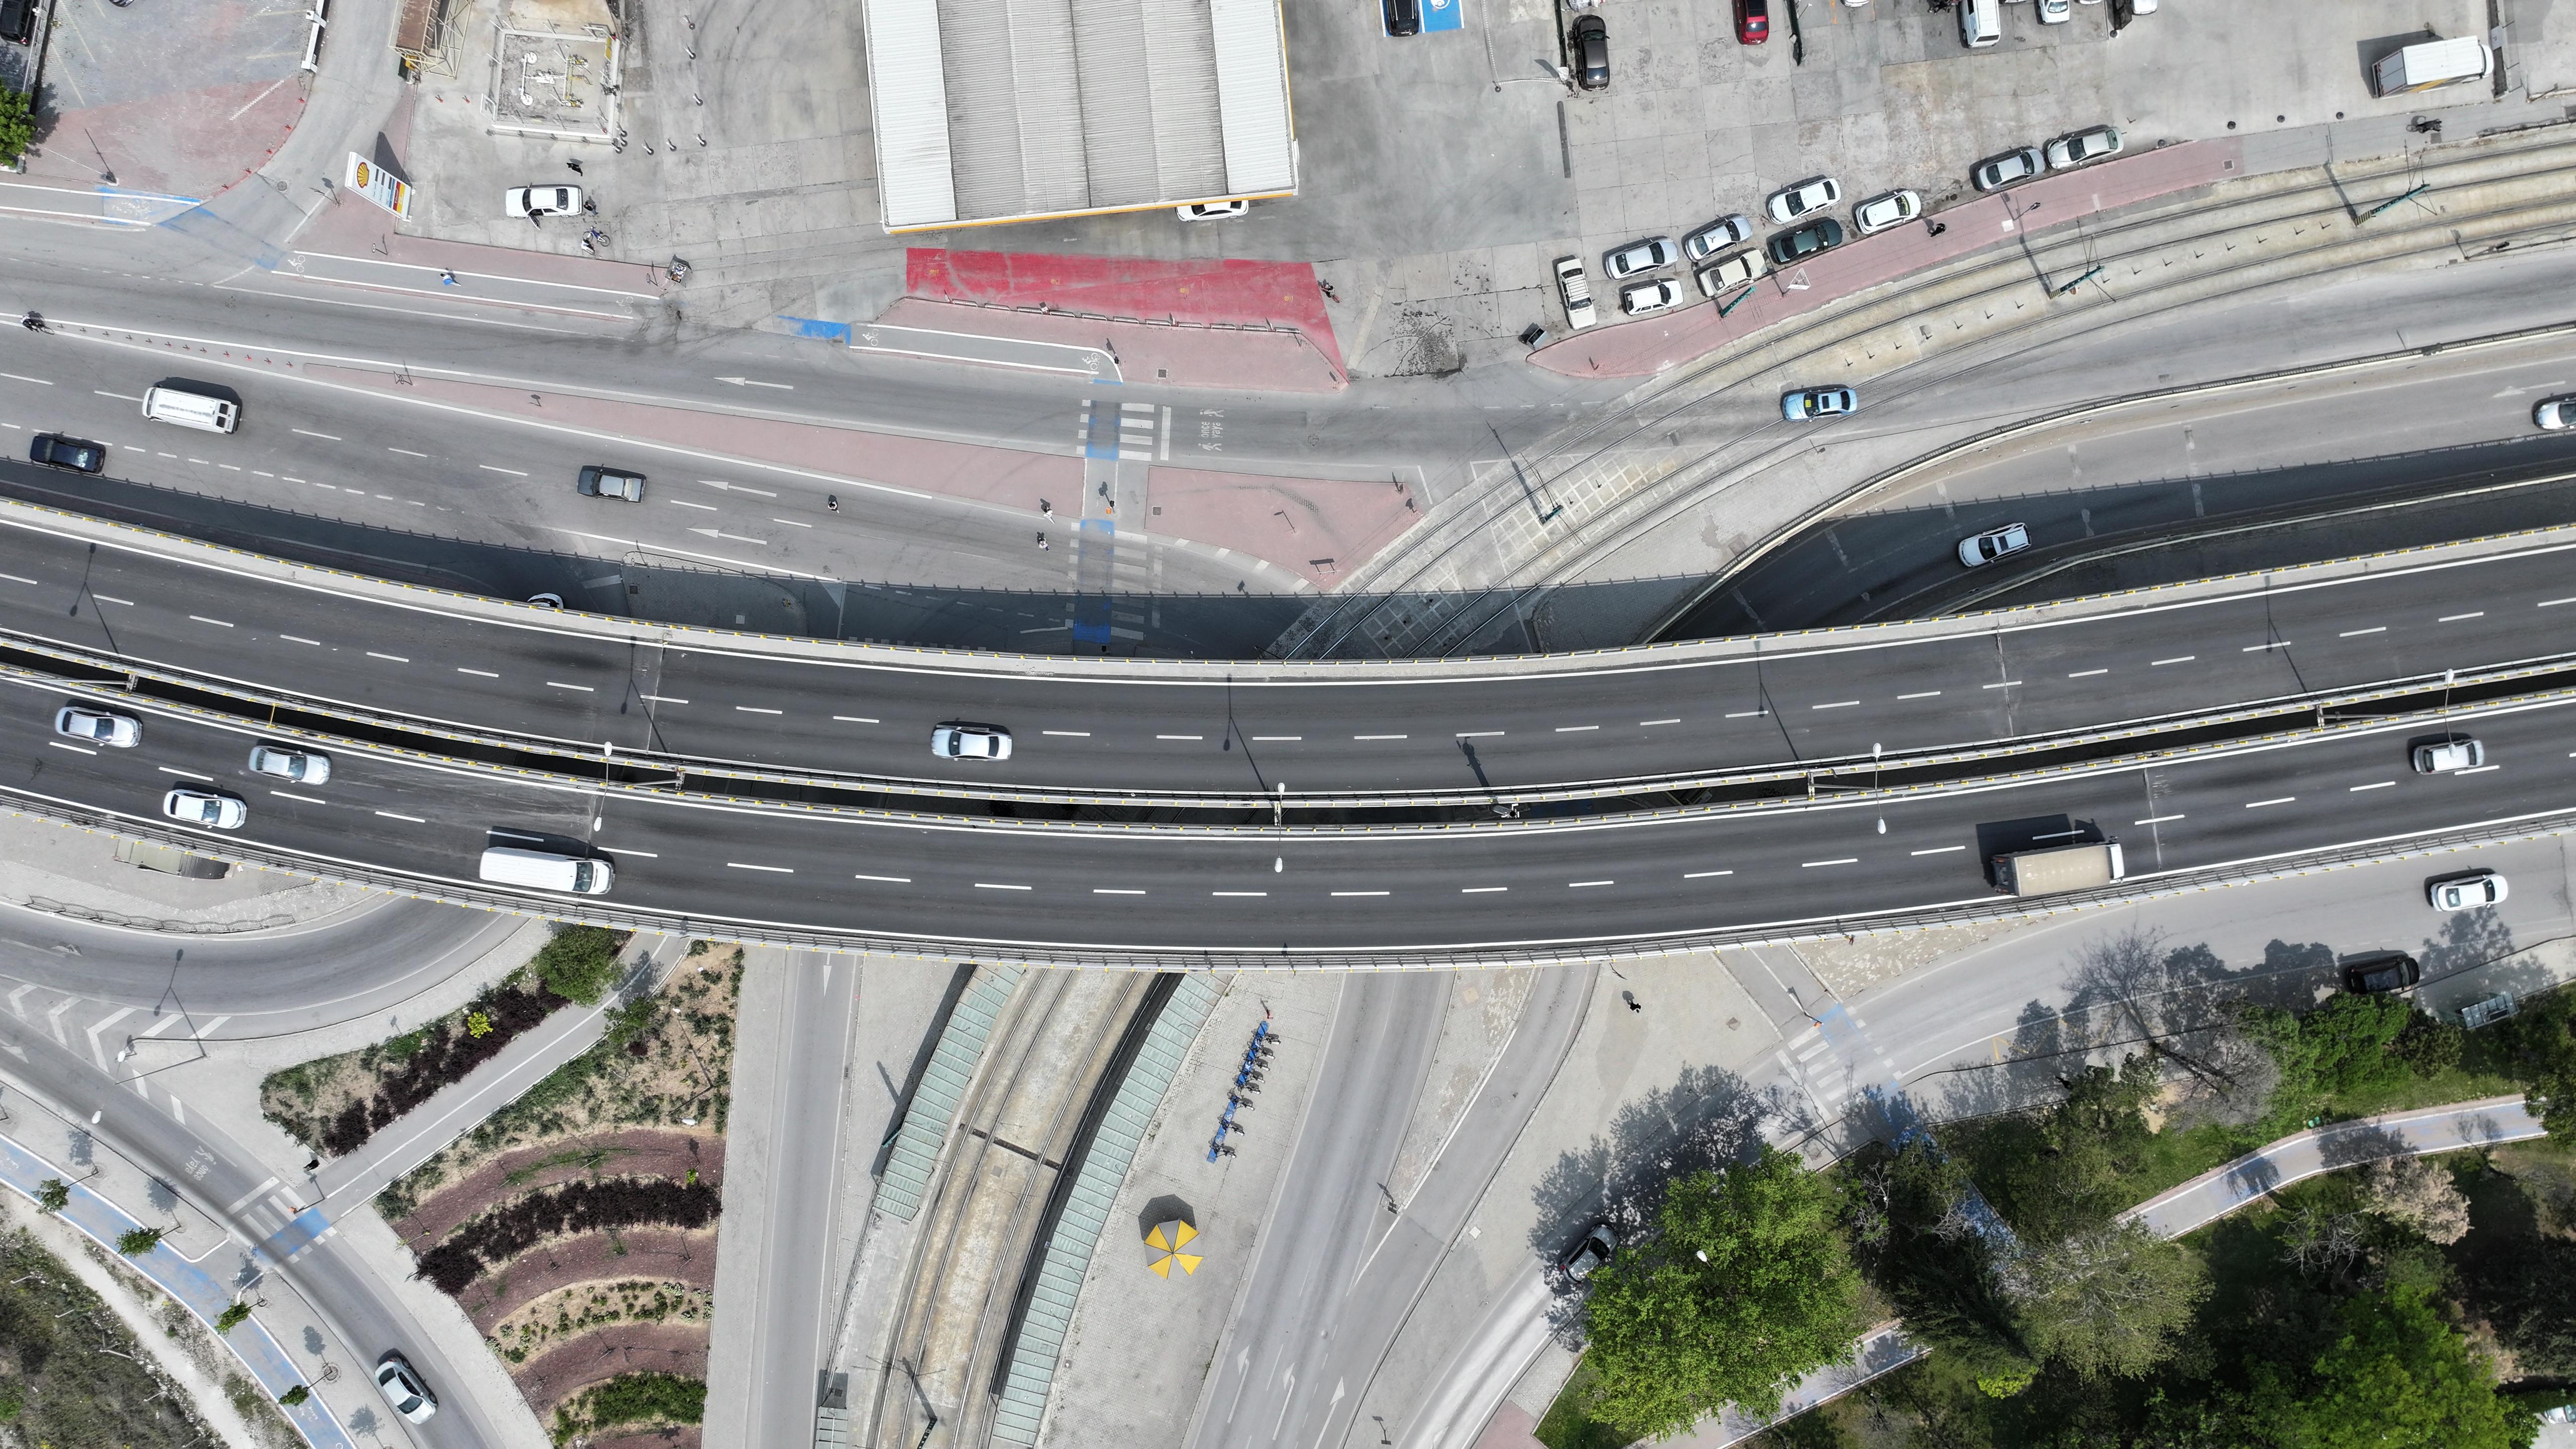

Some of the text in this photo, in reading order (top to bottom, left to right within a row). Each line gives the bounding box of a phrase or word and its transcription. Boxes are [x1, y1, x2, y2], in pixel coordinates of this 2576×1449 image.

[1212, 422, 1223, 438] yaya
[185, 1156, 200, 1174] yaya
[193, 1165, 211, 1181] önce
